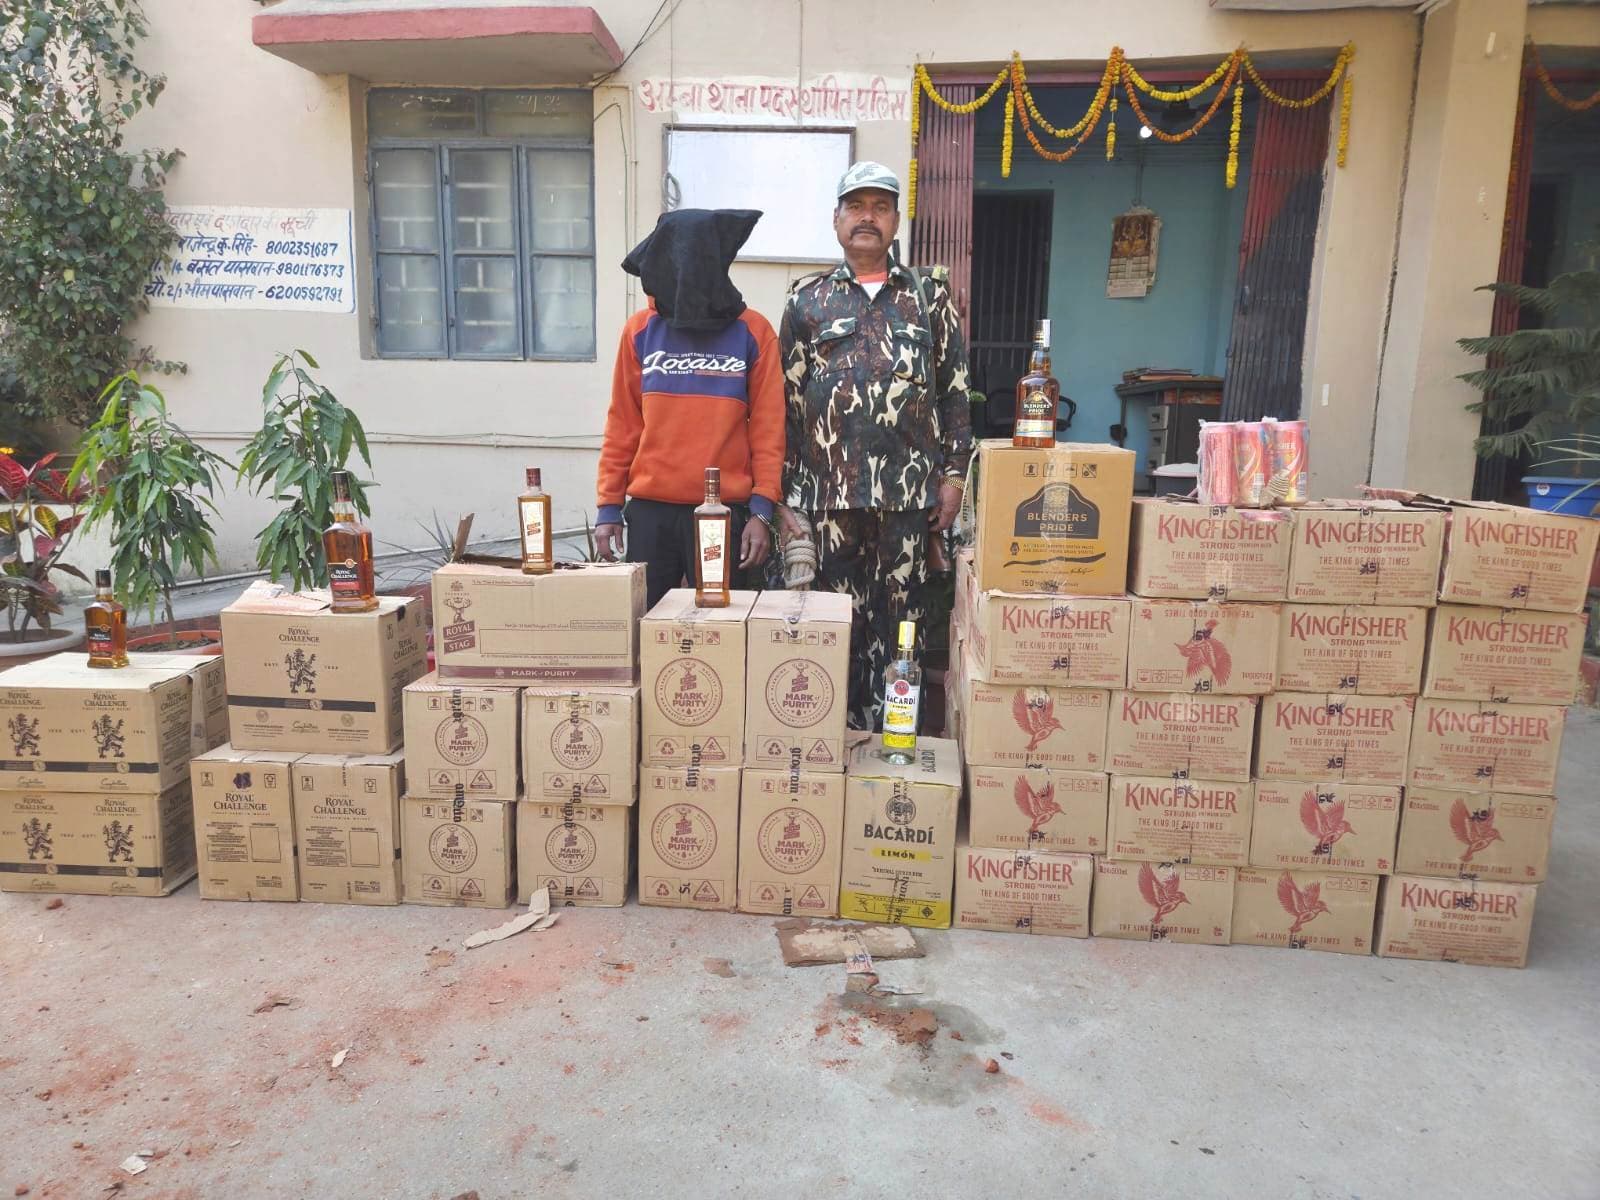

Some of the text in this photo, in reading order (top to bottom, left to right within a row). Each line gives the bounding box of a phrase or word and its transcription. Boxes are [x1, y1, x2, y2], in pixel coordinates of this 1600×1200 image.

[265, 241, 339, 258] 8002351687
[1026, 512, 1089, 523] BLENDERS
[1038, 522, 1074, 532] PRIDE
[1157, 514, 1280, 544] KINGFISHER
[1305, 517, 1427, 548] KINGFISHER
[1464, 516, 1580, 554] KINGFISHER
[1200, 542, 1236, 550] STRONG
[1001, 605, 1113, 635] KINGFISHER
[446, 624, 473, 637] ROYAL
[1289, 611, 1409, 641] KINGFISHER
[1040, 632, 1074, 640] STRONG
[1447, 616, 1570, 648] KINGFISHER
[449, 640, 471, 652] STAG
[1330, 638, 1365, 646] STRONG
[1489, 644, 1524, 653] STRONG
[93, 692, 118, 701] ROYAL
[674, 692, 703, 700] MARK
[785, 692, 814, 701] MARK
[84, 699, 128, 707] CHALLENGE
[672, 699, 708, 708] PURITY
[782, 700, 819, 710] PURITY
[1122, 697, 1242, 728] KINGFISHER
[1275, 701, 1396, 731] KINGFISHER
[1426, 706, 1550, 740] KINGFISHER
[1163, 724, 1198, 733] STRONG
[1316, 728, 1352, 737] STRONG
[450, 739, 472, 747] MARK
[1470, 735, 1506, 745] STRONG
[448, 744, 477, 753] PURITY
[565, 742, 588, 750] MARK
[563, 748, 593, 757] PURITY
[225, 792, 254, 802] ROYAL
[325, 797, 354, 807] ROYAL
[1124, 783, 1239, 813] KINGFISHER
[213, 801, 267, 811] CHALLENGE
[313, 805, 367, 816] CHALLENGE
[864, 824, 935, 845] BACARDÍ
[670, 836, 698, 845] MARK
[777, 840, 805, 849] MARK
[668, 843, 702, 852] PURITY
[775, 847, 810, 856] PURITY
[439, 853, 468, 862] PURITY
[440, 849, 464, 857] MARK
[558, 853, 586, 861] PURITY
[881, 850, 916, 860] LIMÓN
[967, 854, 1074, 886] KINGFISHER
[1004, 882, 1036, 890] STRONG
[1400, 883, 1519, 918] KINGFISHER
[1441, 912, 1476, 922] STRONG
